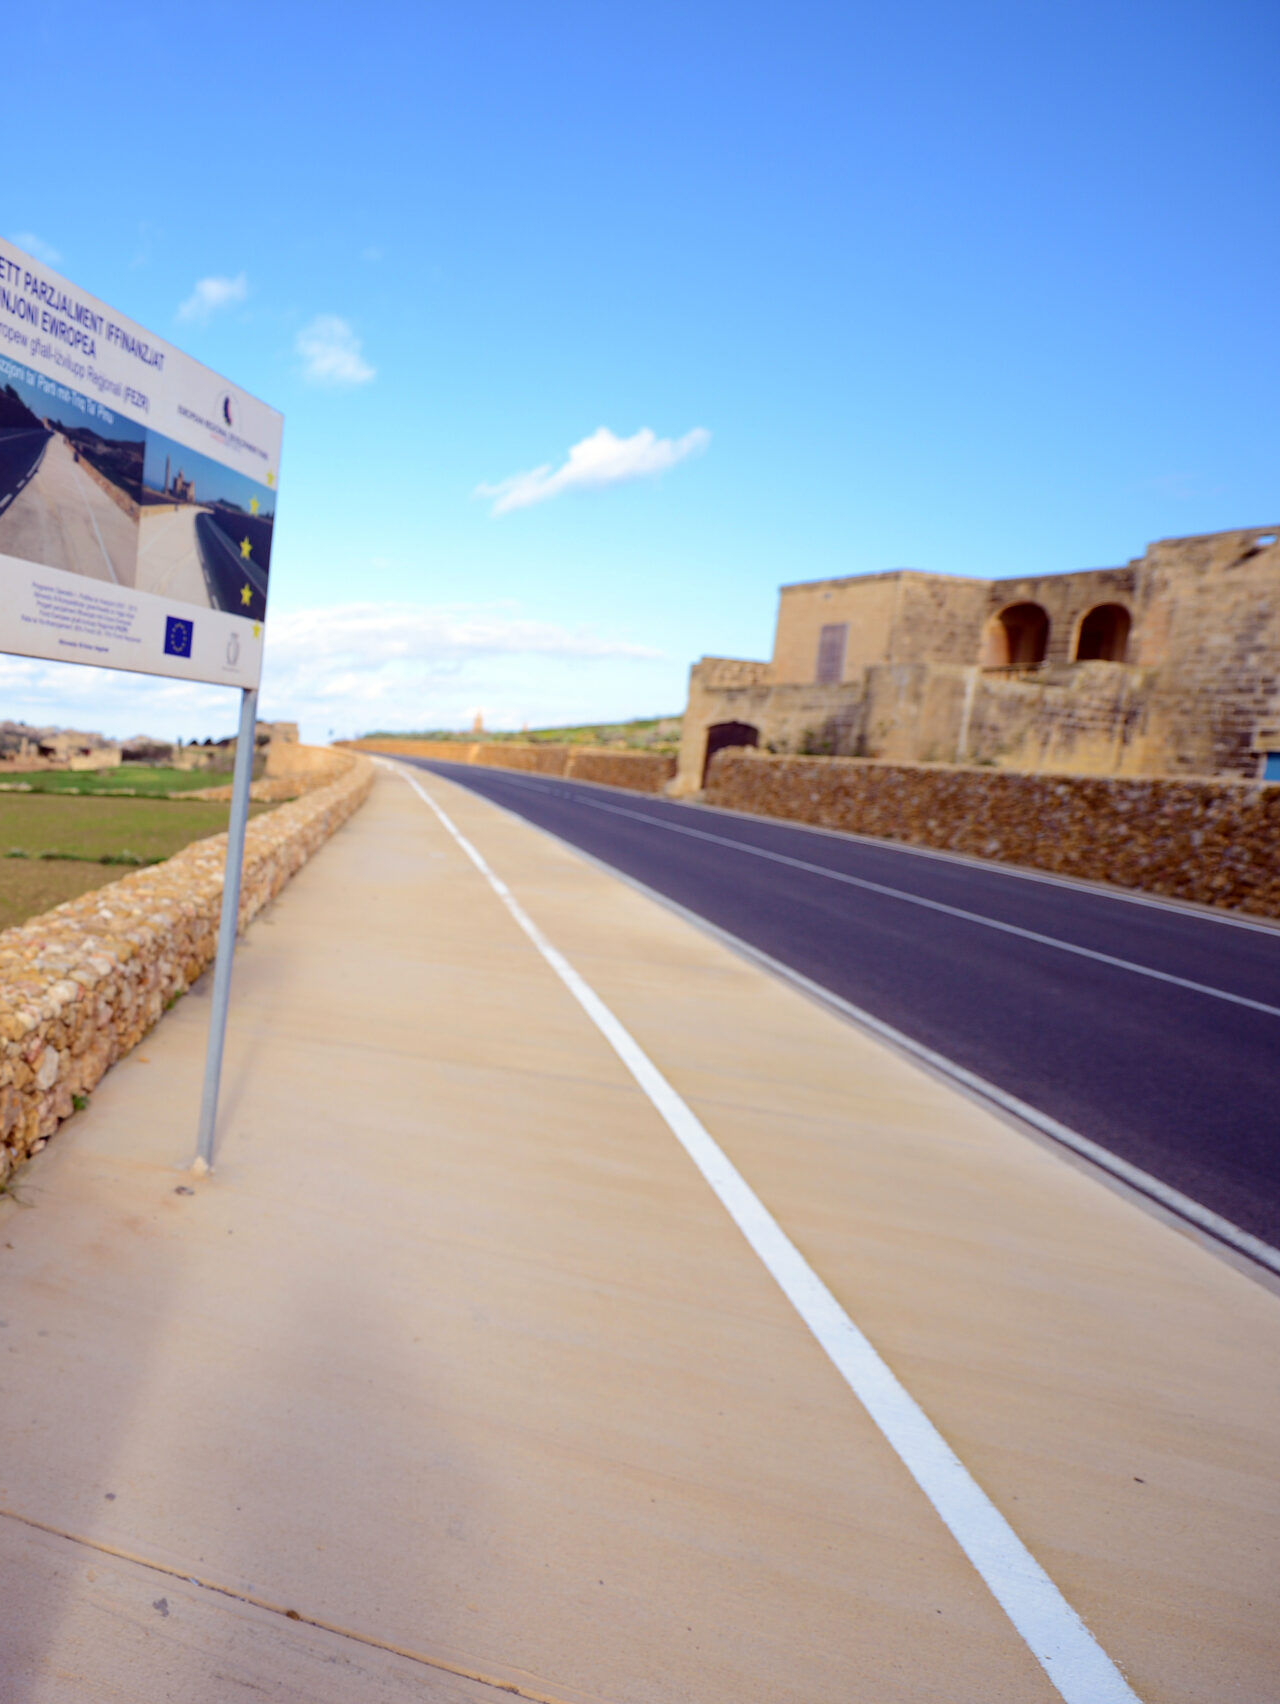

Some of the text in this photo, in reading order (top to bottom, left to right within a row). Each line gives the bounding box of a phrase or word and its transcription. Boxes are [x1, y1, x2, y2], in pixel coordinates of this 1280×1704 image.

[24, 271, 104, 336] PARZJALMENT
[106, 322, 165, 371] IFFINANZJAT
[41, 311, 96, 359] EWROPEA
